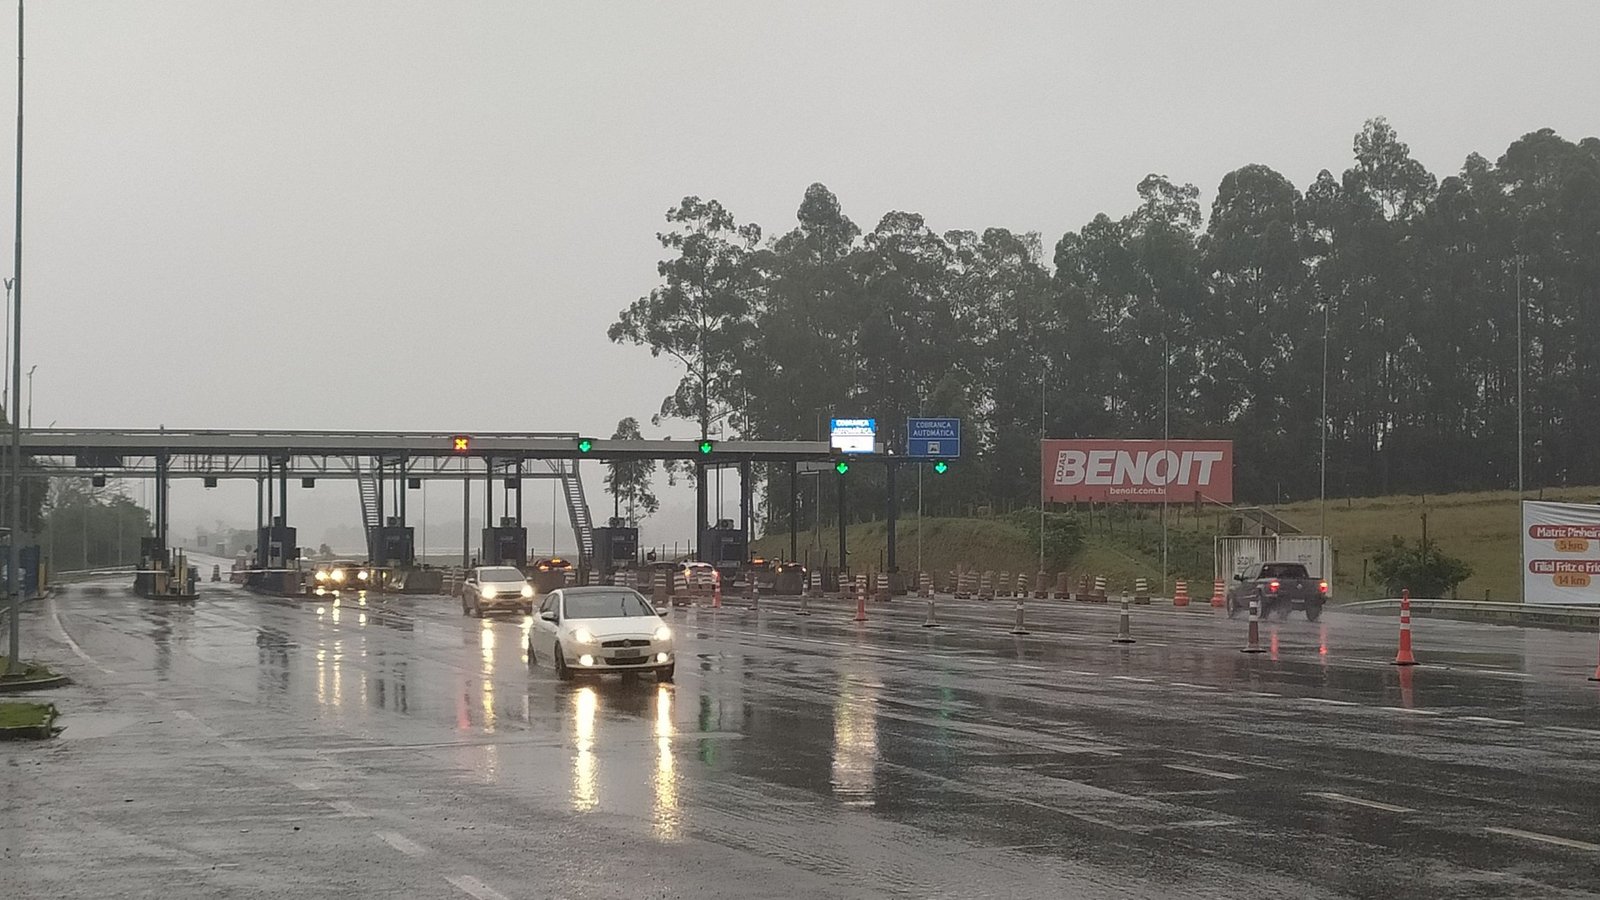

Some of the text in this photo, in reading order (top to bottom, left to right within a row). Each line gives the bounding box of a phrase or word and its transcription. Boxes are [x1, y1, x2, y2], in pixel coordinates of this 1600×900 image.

[915, 421, 951, 430] COBRANÇA
[912, 428, 955, 437] AUTOMÁTICA
[1053, 450, 1223, 486] BENOIT
[1055, 452, 1067, 482] LOJAS
[1536, 527, 1600, 537] Matriz Pinheir
[1560, 541, 1584, 550] 5 km
[1534, 561, 1555, 572] Filial
[1556, 562, 1577, 572] Fritz
[1578, 564, 1585, 572] e
[1559, 576, 1586, 586] 14 km
